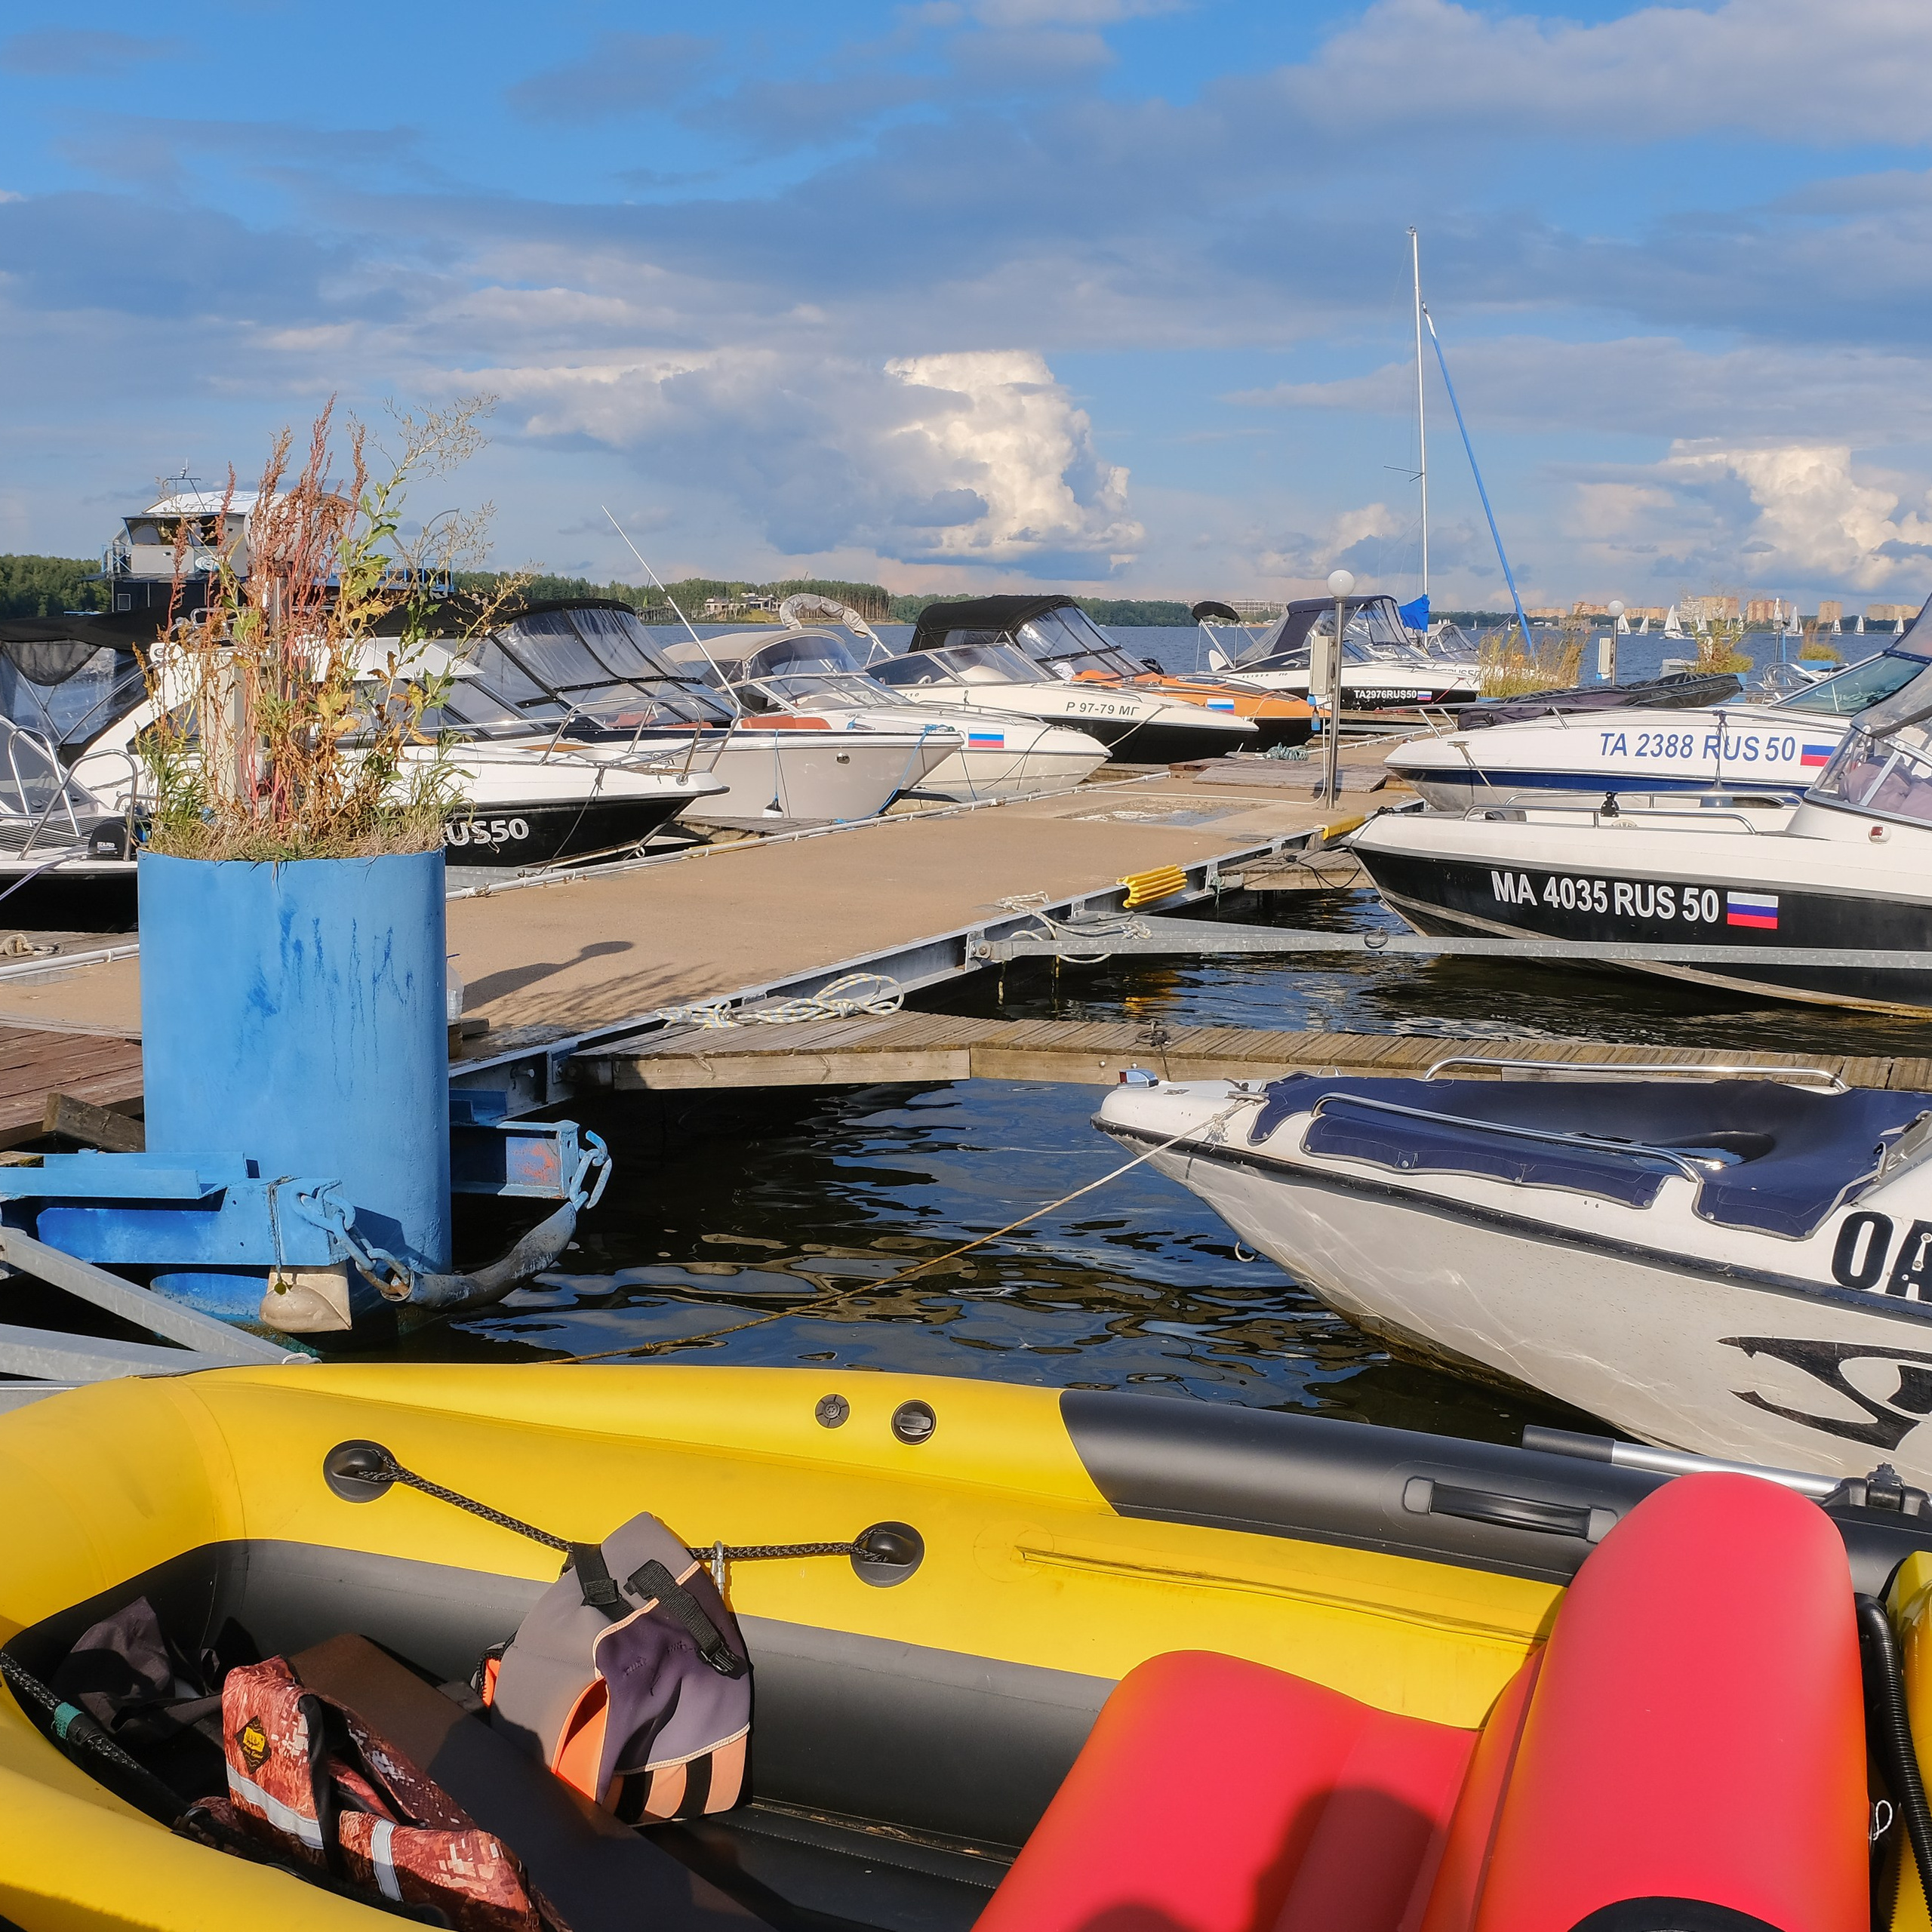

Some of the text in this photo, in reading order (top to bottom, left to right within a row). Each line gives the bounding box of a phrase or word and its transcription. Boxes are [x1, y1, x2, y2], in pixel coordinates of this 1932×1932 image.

[1354, 690, 1417, 699] TA2976RUS50
[1079, 703, 1115, 715] 97-79
[1118, 706, 1140, 716] МГ
[1600, 733, 1795, 761] TA 2388 RUS 50
[441, 818, 529, 846] US50
[1491, 871, 1719, 922] MA 4035 RUS 50
